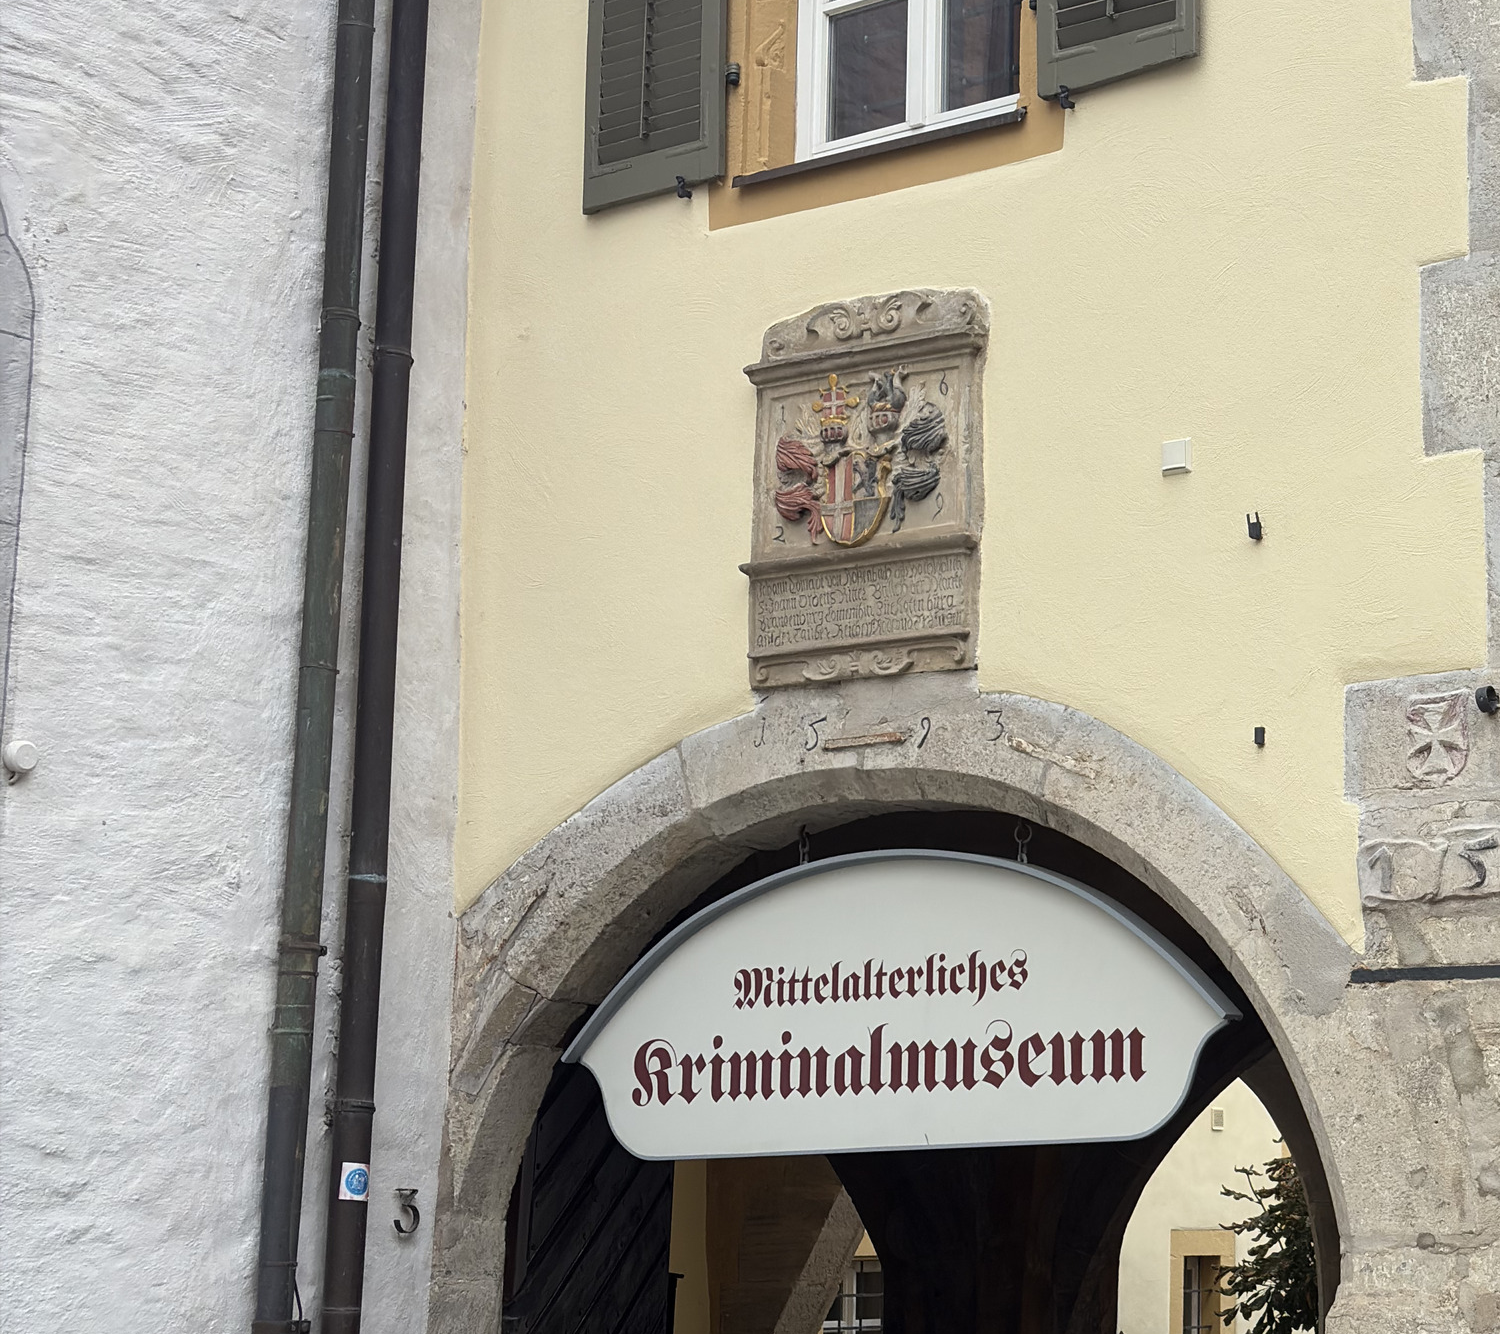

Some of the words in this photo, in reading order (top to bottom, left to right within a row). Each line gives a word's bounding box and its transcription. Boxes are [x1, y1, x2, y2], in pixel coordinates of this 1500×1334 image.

[732, 948, 1028, 1011] Mittelalterliches
[631, 1018, 1147, 1108] Kriminalmuseum
[393, 1188, 420, 1234] 3
